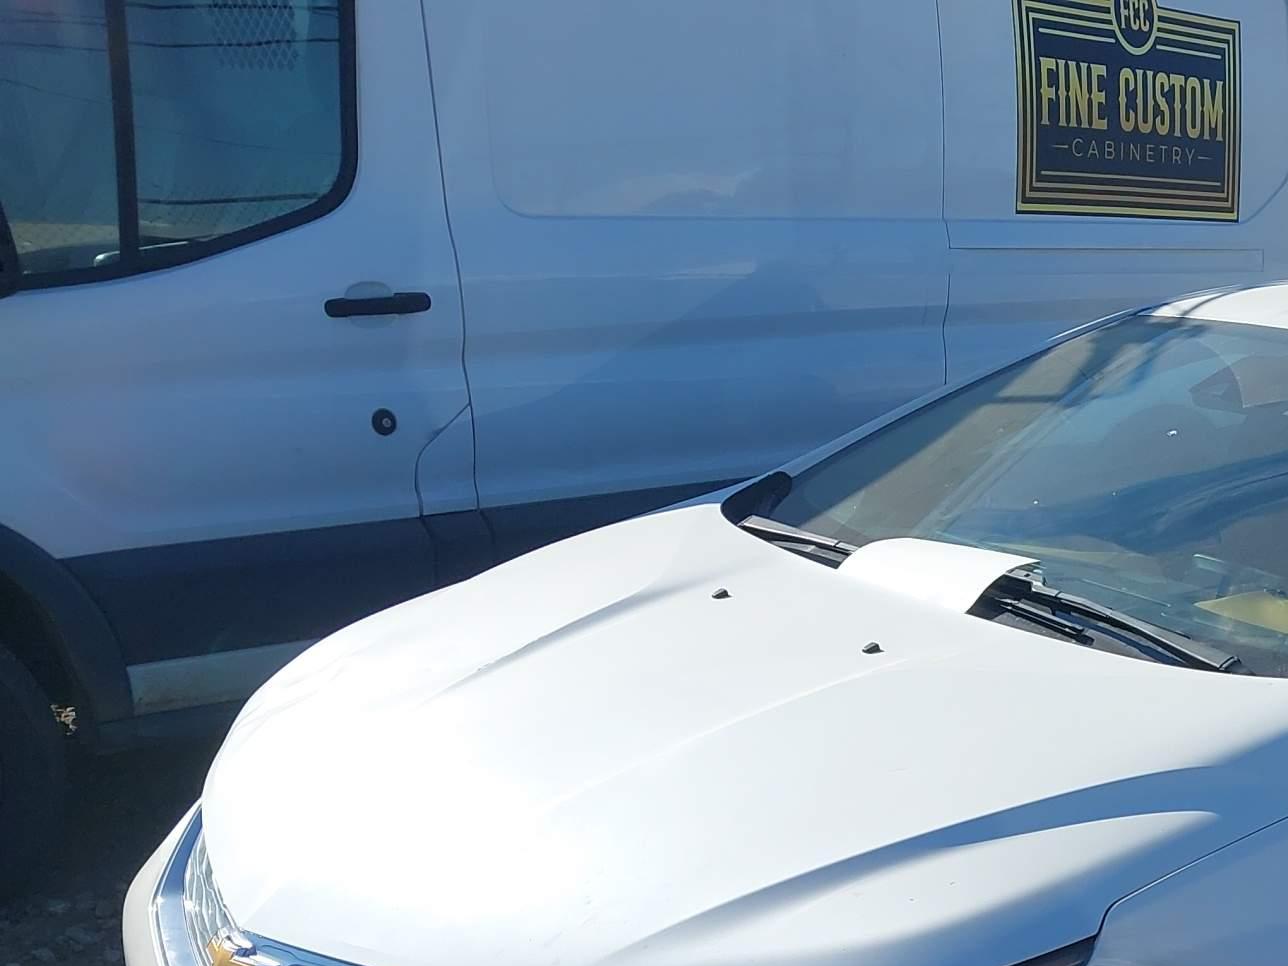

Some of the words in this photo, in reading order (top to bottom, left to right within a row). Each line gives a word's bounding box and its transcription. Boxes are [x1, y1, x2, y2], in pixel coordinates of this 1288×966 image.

[1120, 0, 1150, 32] FCC
[1039, 56, 1108, 130] FINE
[1118, 67, 1224, 142] CUSTOM
[1071, 137, 1196, 166] CABINETRY
